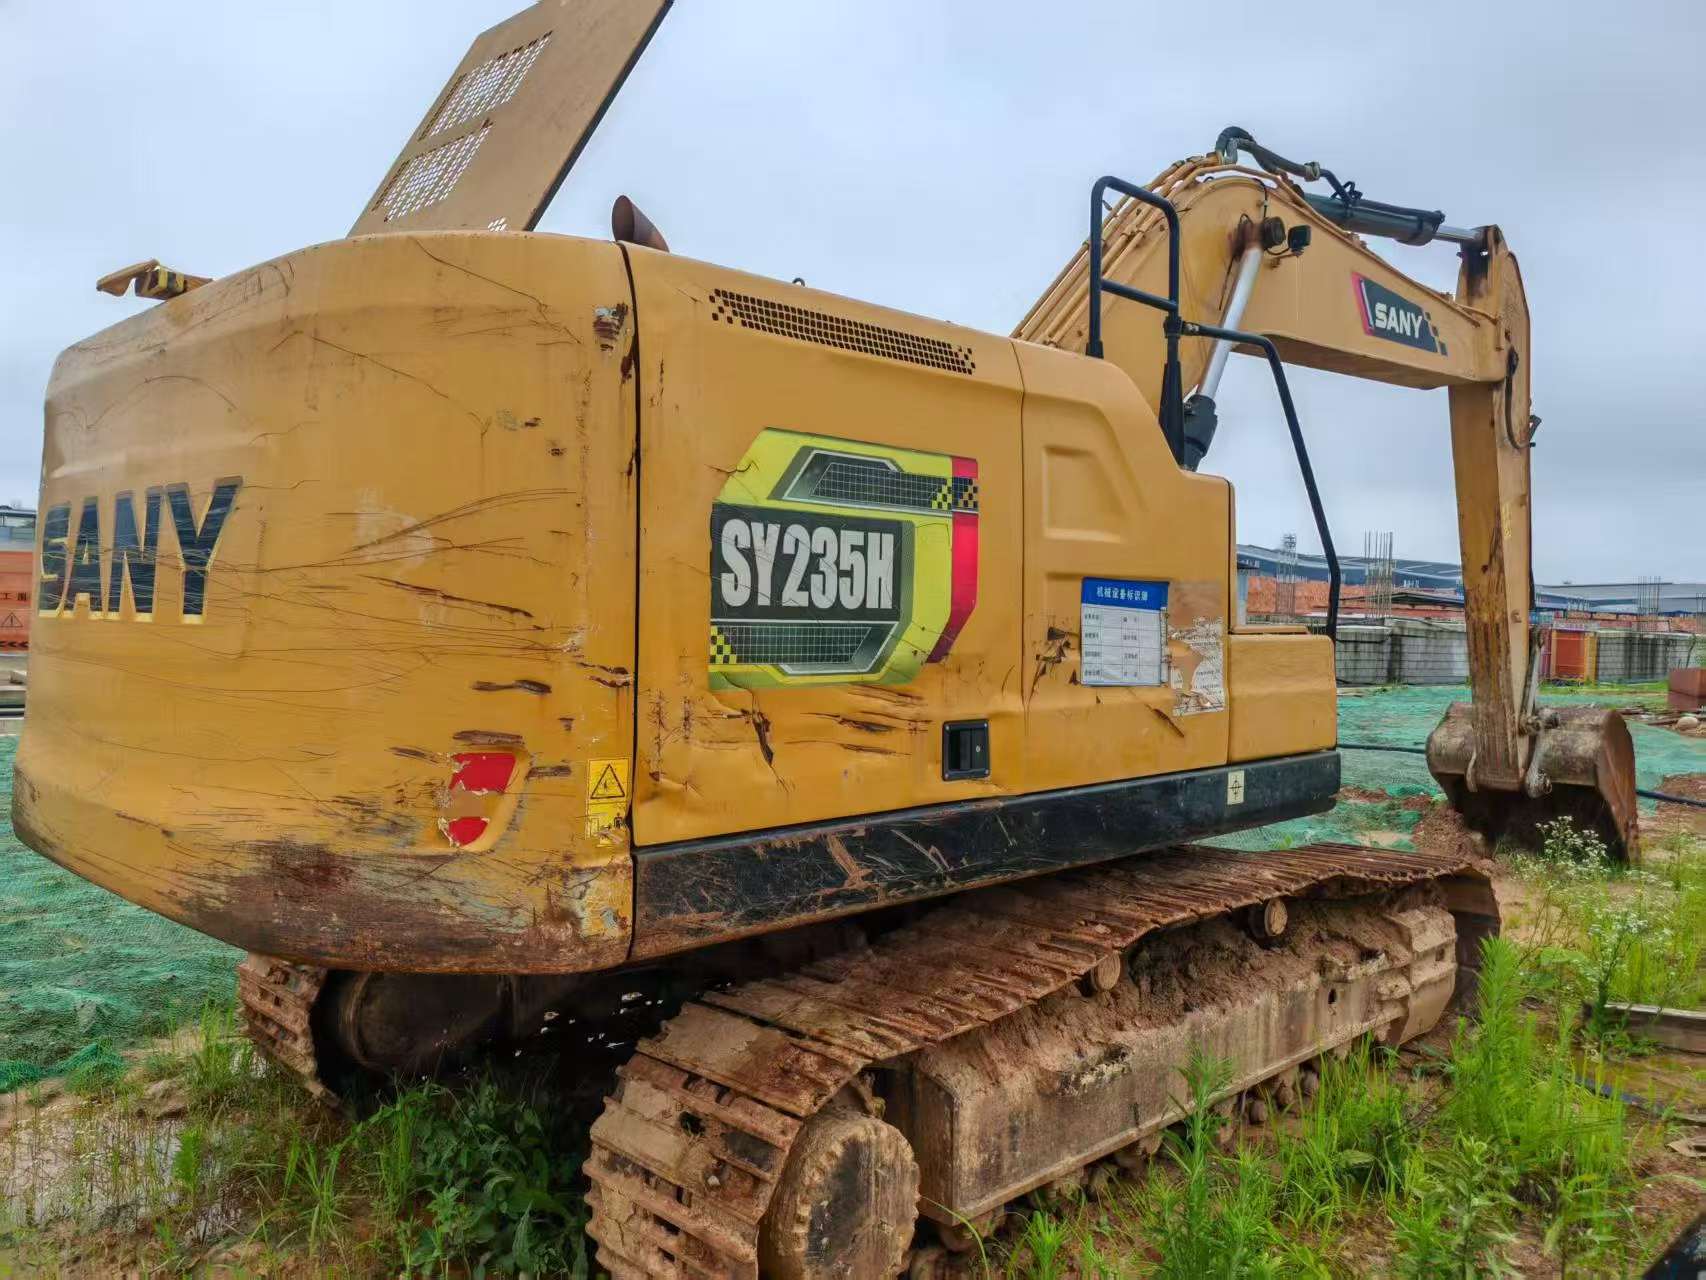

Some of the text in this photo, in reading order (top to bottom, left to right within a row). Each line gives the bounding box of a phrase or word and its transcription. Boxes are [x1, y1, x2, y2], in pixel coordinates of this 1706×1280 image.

[1375, 303, 1423, 338] SANY
[38, 476, 243, 624] SANY
[721, 518, 895, 609] SY235H
